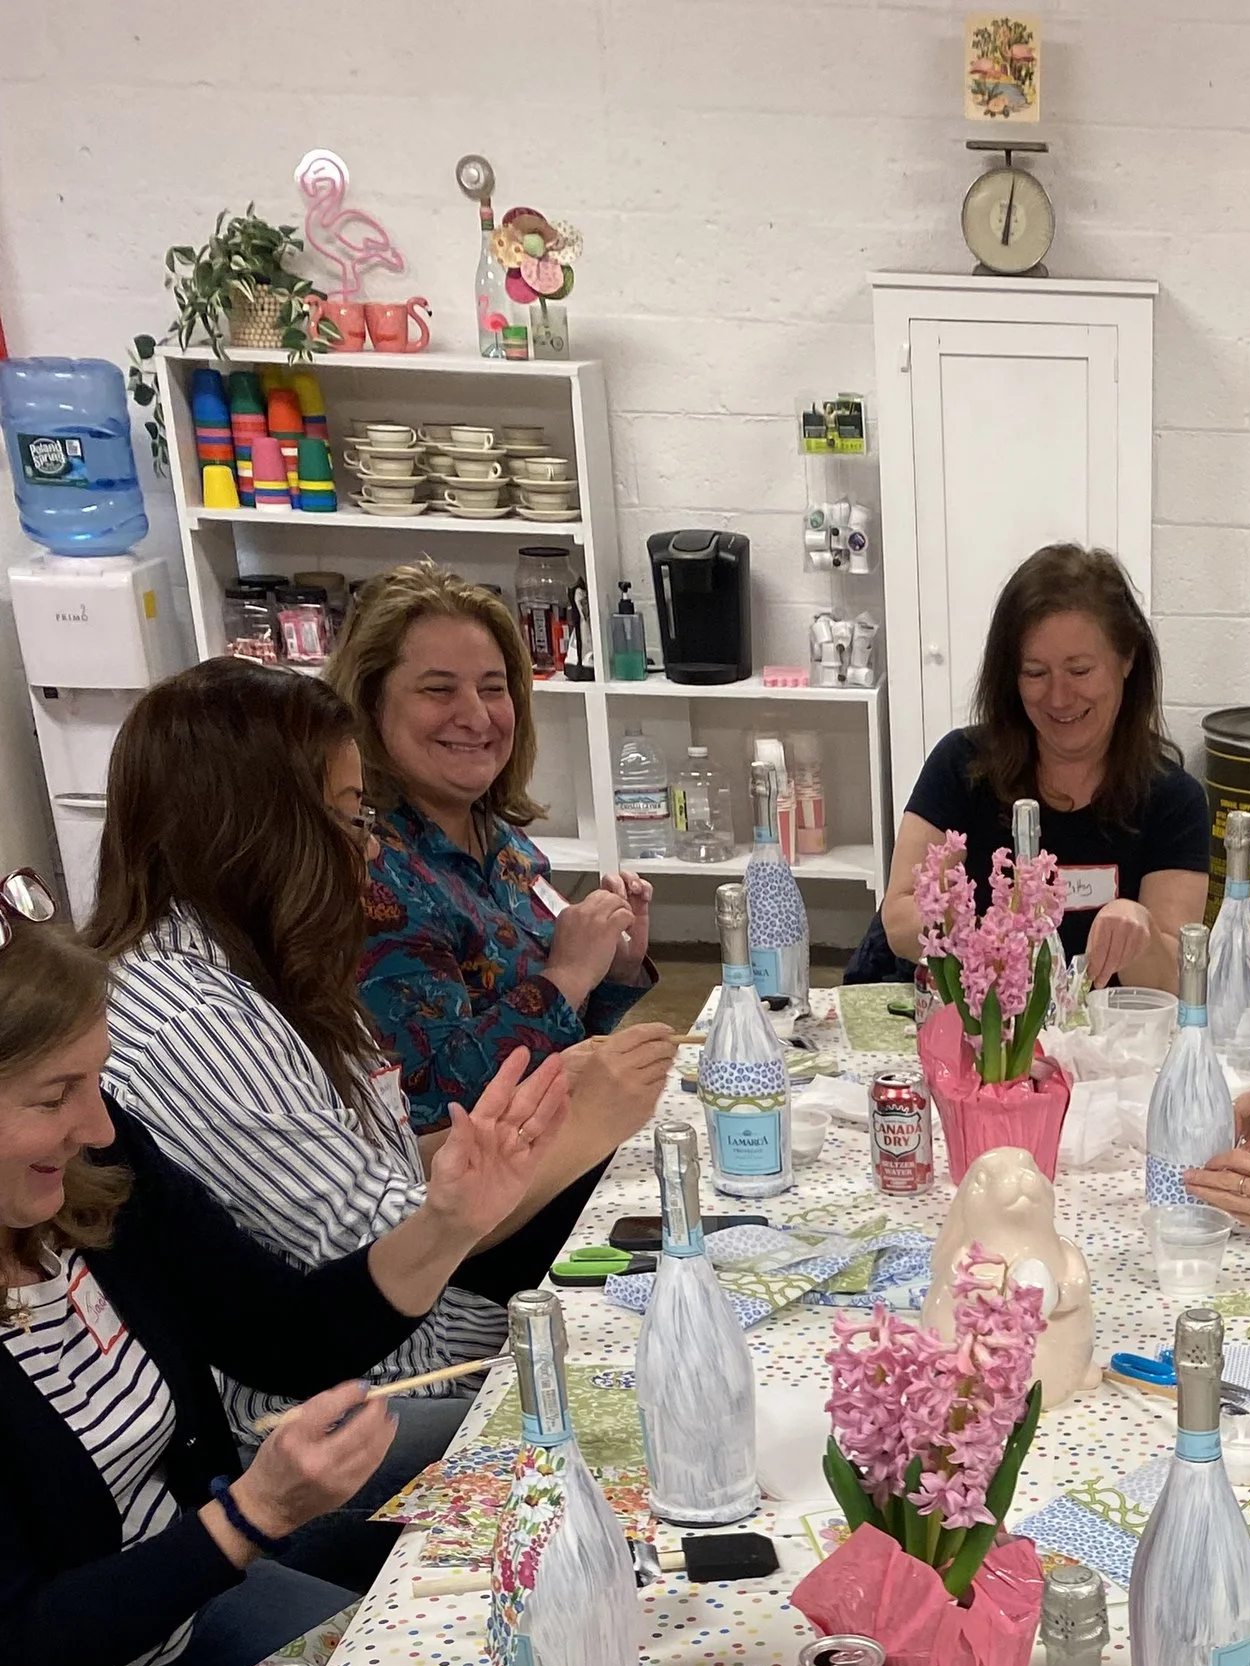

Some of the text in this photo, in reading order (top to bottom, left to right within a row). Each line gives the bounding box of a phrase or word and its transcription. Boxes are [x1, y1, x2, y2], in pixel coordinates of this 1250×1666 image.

[29, 439, 63, 454] Poland
[33, 452, 66, 469] Spring
[873, 1120, 922, 1134] CANADA
[883, 1135, 910, 1147] DRY
[882, 1160, 916, 1169] SELTZER
[885, 1168, 913, 1176] WATER
